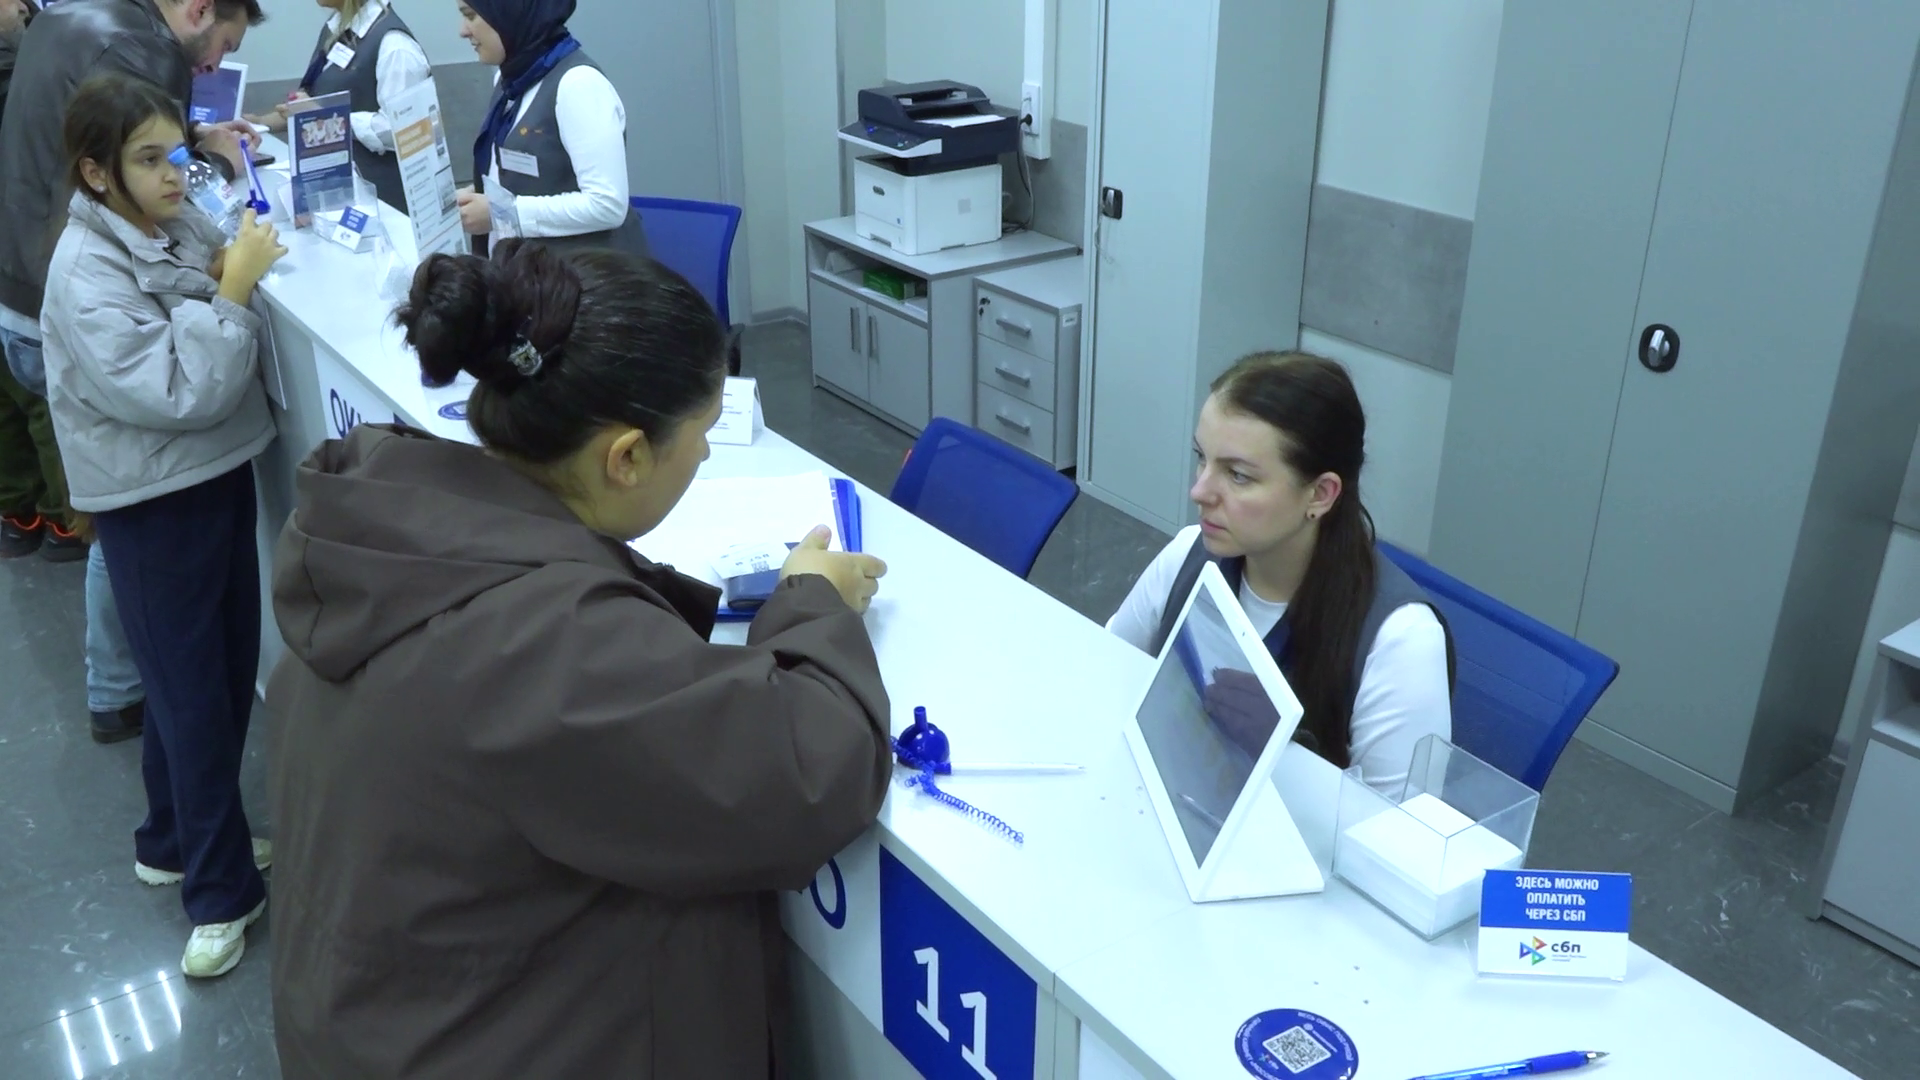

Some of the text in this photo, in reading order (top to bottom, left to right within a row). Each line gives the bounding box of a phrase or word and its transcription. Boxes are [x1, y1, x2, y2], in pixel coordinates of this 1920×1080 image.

[1515, 876, 1599, 890] ЗДЕСЬ МОЖНО
[1527, 892, 1586, 906] ОПЛАТИТЬ
[1525, 908, 1586, 922] ЧЕРЕЗ СБП
[1551, 941, 1581, 953] сбп
[913, 946, 997, 1080] 11
